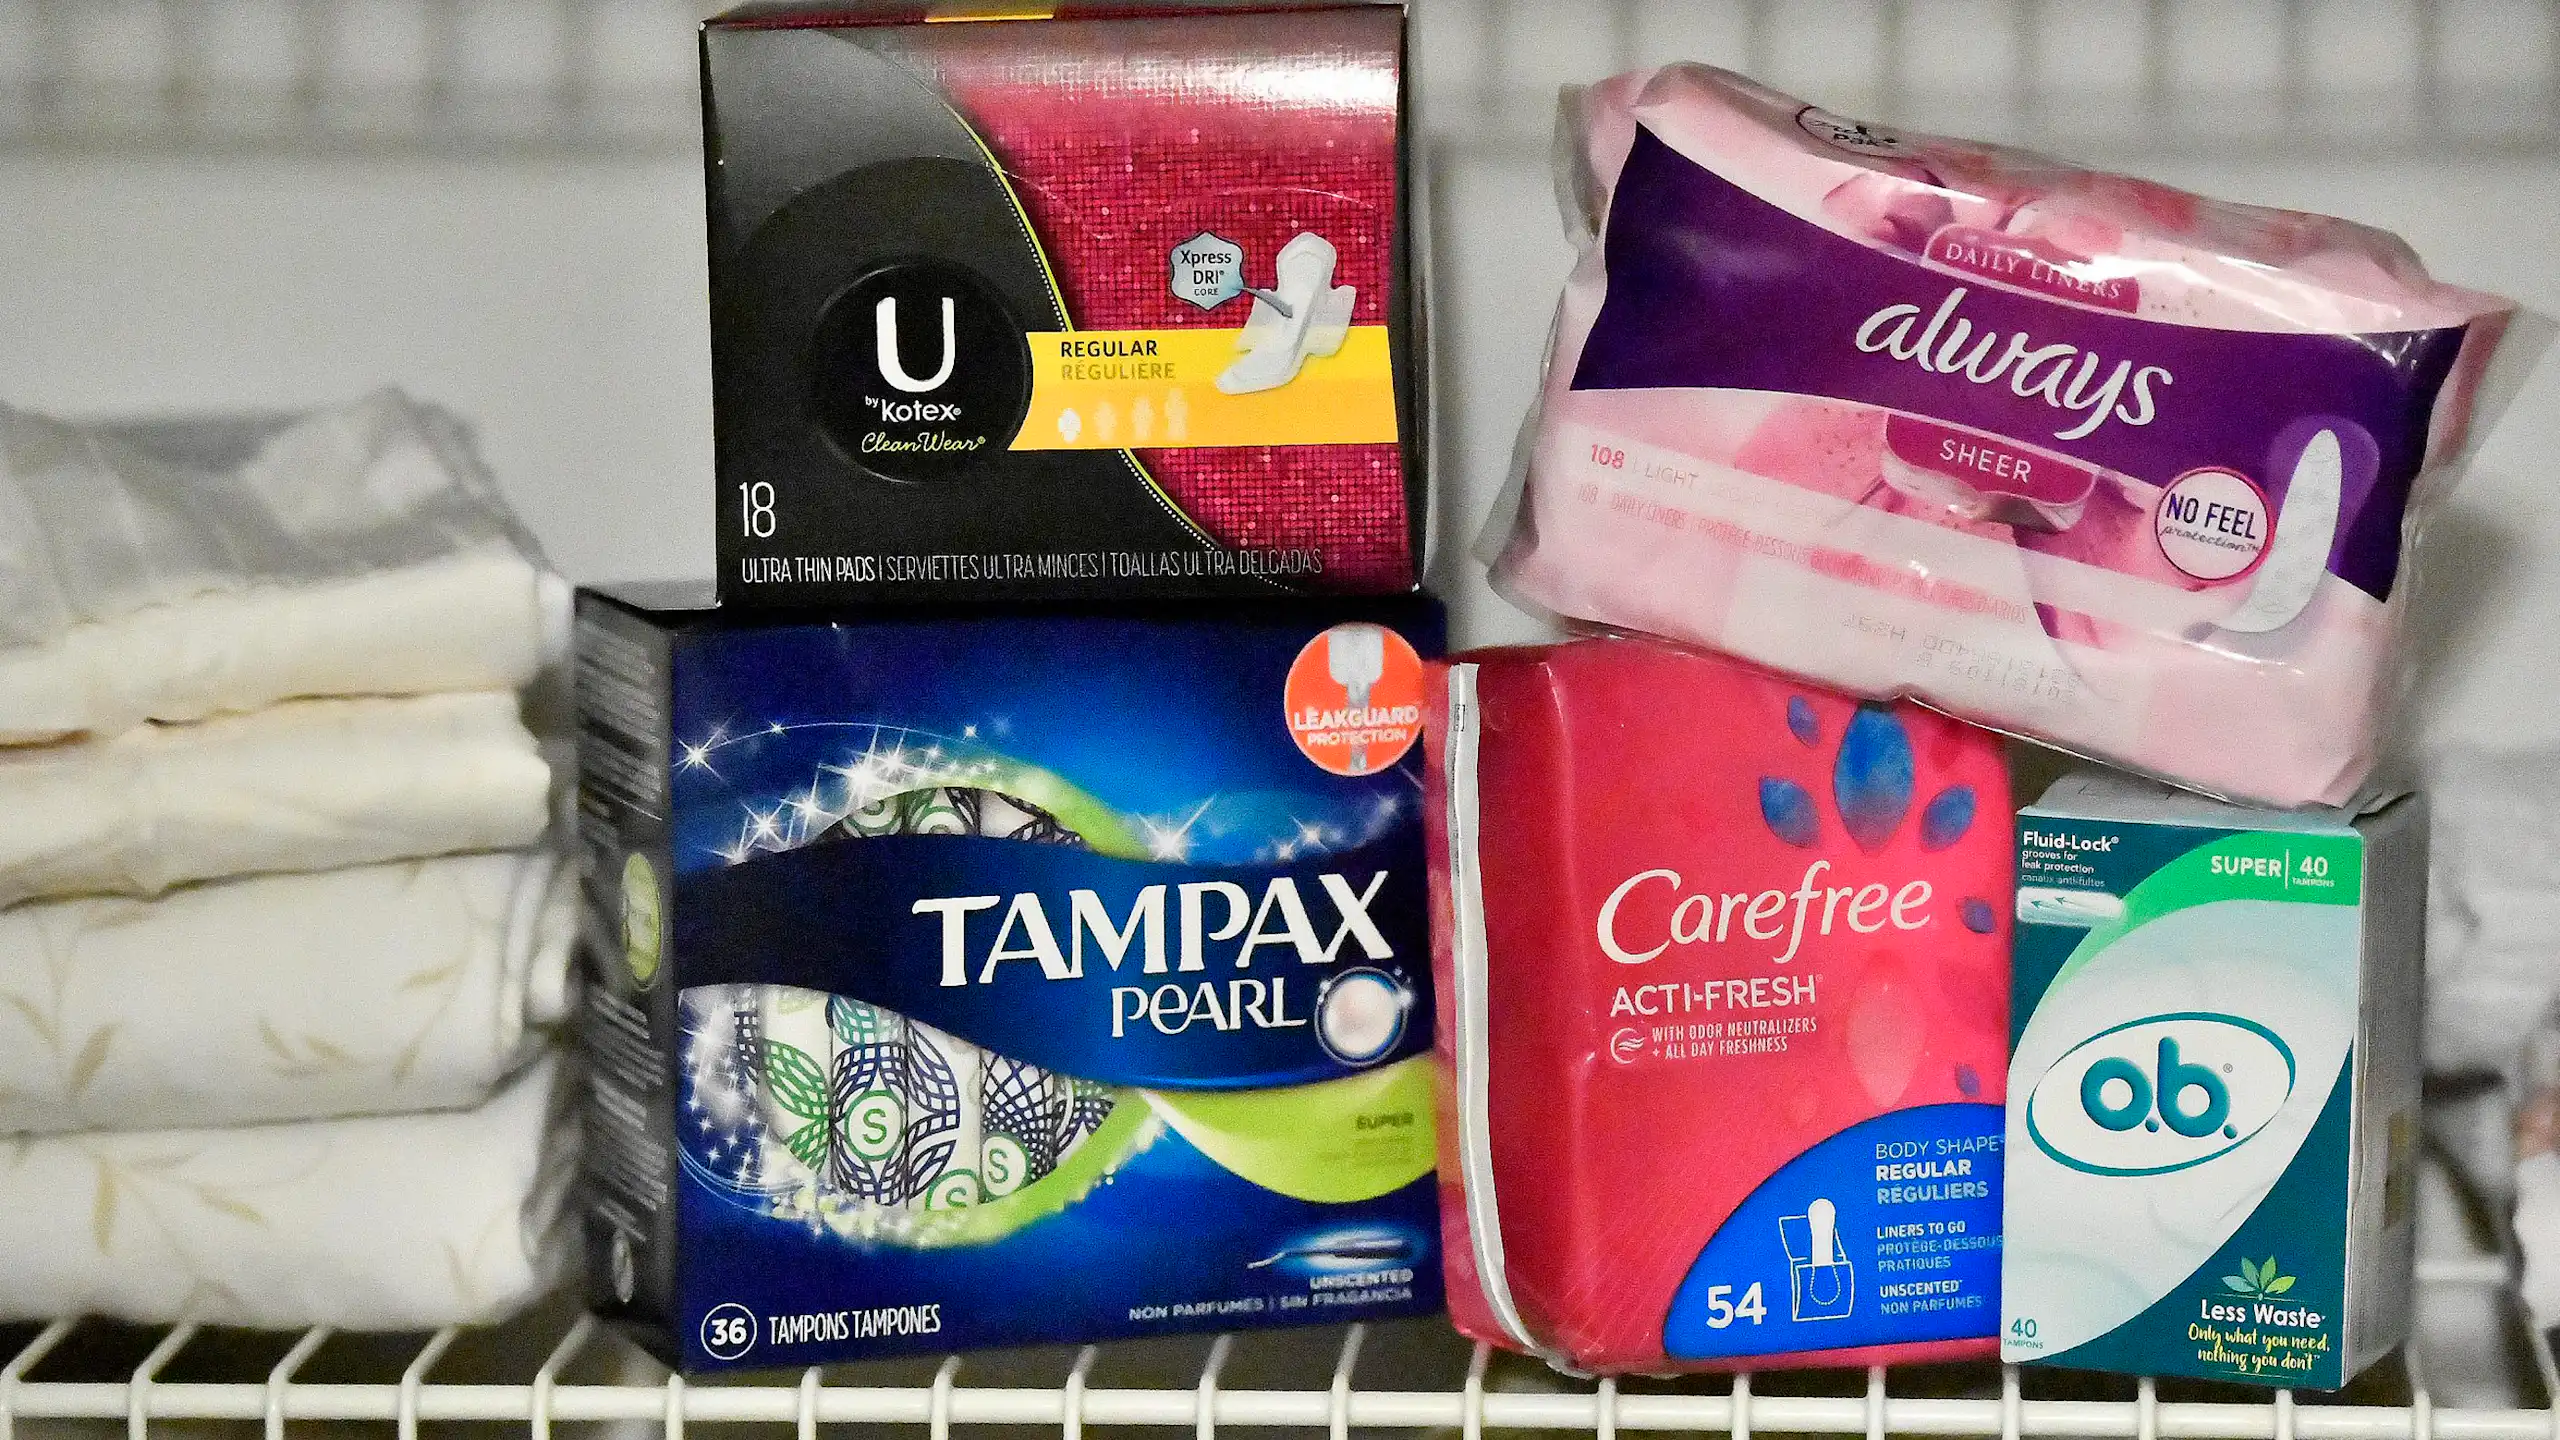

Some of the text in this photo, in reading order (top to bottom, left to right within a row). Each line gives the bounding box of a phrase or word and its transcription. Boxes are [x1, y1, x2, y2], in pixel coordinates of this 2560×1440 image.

[1180, 249, 1232, 268] Xpress
[1945, 242, 2123, 300] DAILY LINERS
[1194, 288, 1219, 296] CORE
[876, 296, 956, 393] U
[1060, 339, 1158, 358] REGULAR
[1855, 286, 2174, 441] always
[865, 395, 879, 408] by
[1590, 442, 1625, 470] 108
[1939, 438, 2033, 485] SHEER
[739, 481, 777, 539] 18
[2166, 493, 2256, 540] NO FEEL
[742, 557, 792, 584] ULTRA
[795, 556, 832, 583] THIN
[836, 556, 876, 582] PADS
[886, 554, 979, 581] SERVIETTES
[983, 554, 1034, 580] ULTRA
[1038, 553, 1099, 578] MINCES
[1111, 551, 1181, 577] TOALLAS
[1183, 550, 1236, 576] ULTRA
[1294, 704, 1419, 731] LEAKGUARD
[1307, 727, 1408, 746] PROTECTION
[2022, 850, 2079, 860] grooves for
[2022, 859, 2095, 874] leak protection
[2210, 855, 2329, 878] SUPER 40
[2292, 877, 2335, 887] TAMPONS
[1596, 860, 1934, 965] Carefree
[912, 870, 1395, 987] TAMPAX
[1111, 976, 1307, 1038] PEARL
[1652, 1016, 1818, 1043] WITH ODOR NEUTRALIZERS
[1665, 1042, 1686, 1059] ALL
[1691, 1041, 1715, 1057] DAY
[1719, 1035, 1788, 1056] FRESHNESS
[863, 1107, 888, 1145] S
[1876, 1140, 1930, 1160] BODY
[1876, 1159, 1972, 1181] REGULAR
[1877, 1221, 1966, 1239] LINERS TO GO
[1878, 1256, 1951, 1273] PRATIQUES
[1129, 1306, 1168, 1322] NON
[1173, 1297, 1264, 1318] PARFUMES
[1706, 1281, 1768, 1329] 54
[1881, 1296, 1982, 1315] NON PARFUMES
[2201, 1298, 2247, 1323] Less
[711, 1317, 748, 1347] 36
[769, 1303, 942, 1345] TAMPONS TAMPONES
[2011, 1317, 2037, 1339] 40
[2003, 1337, 2044, 1350] TAMPONS
[2188, 1322, 2223, 1347] Only
[2225, 1326, 2257, 1345] what
[2262, 1334, 2288, 1354] you
[2198, 1346, 2248, 1371] nothing
[2251, 1354, 2277, 1373] you
